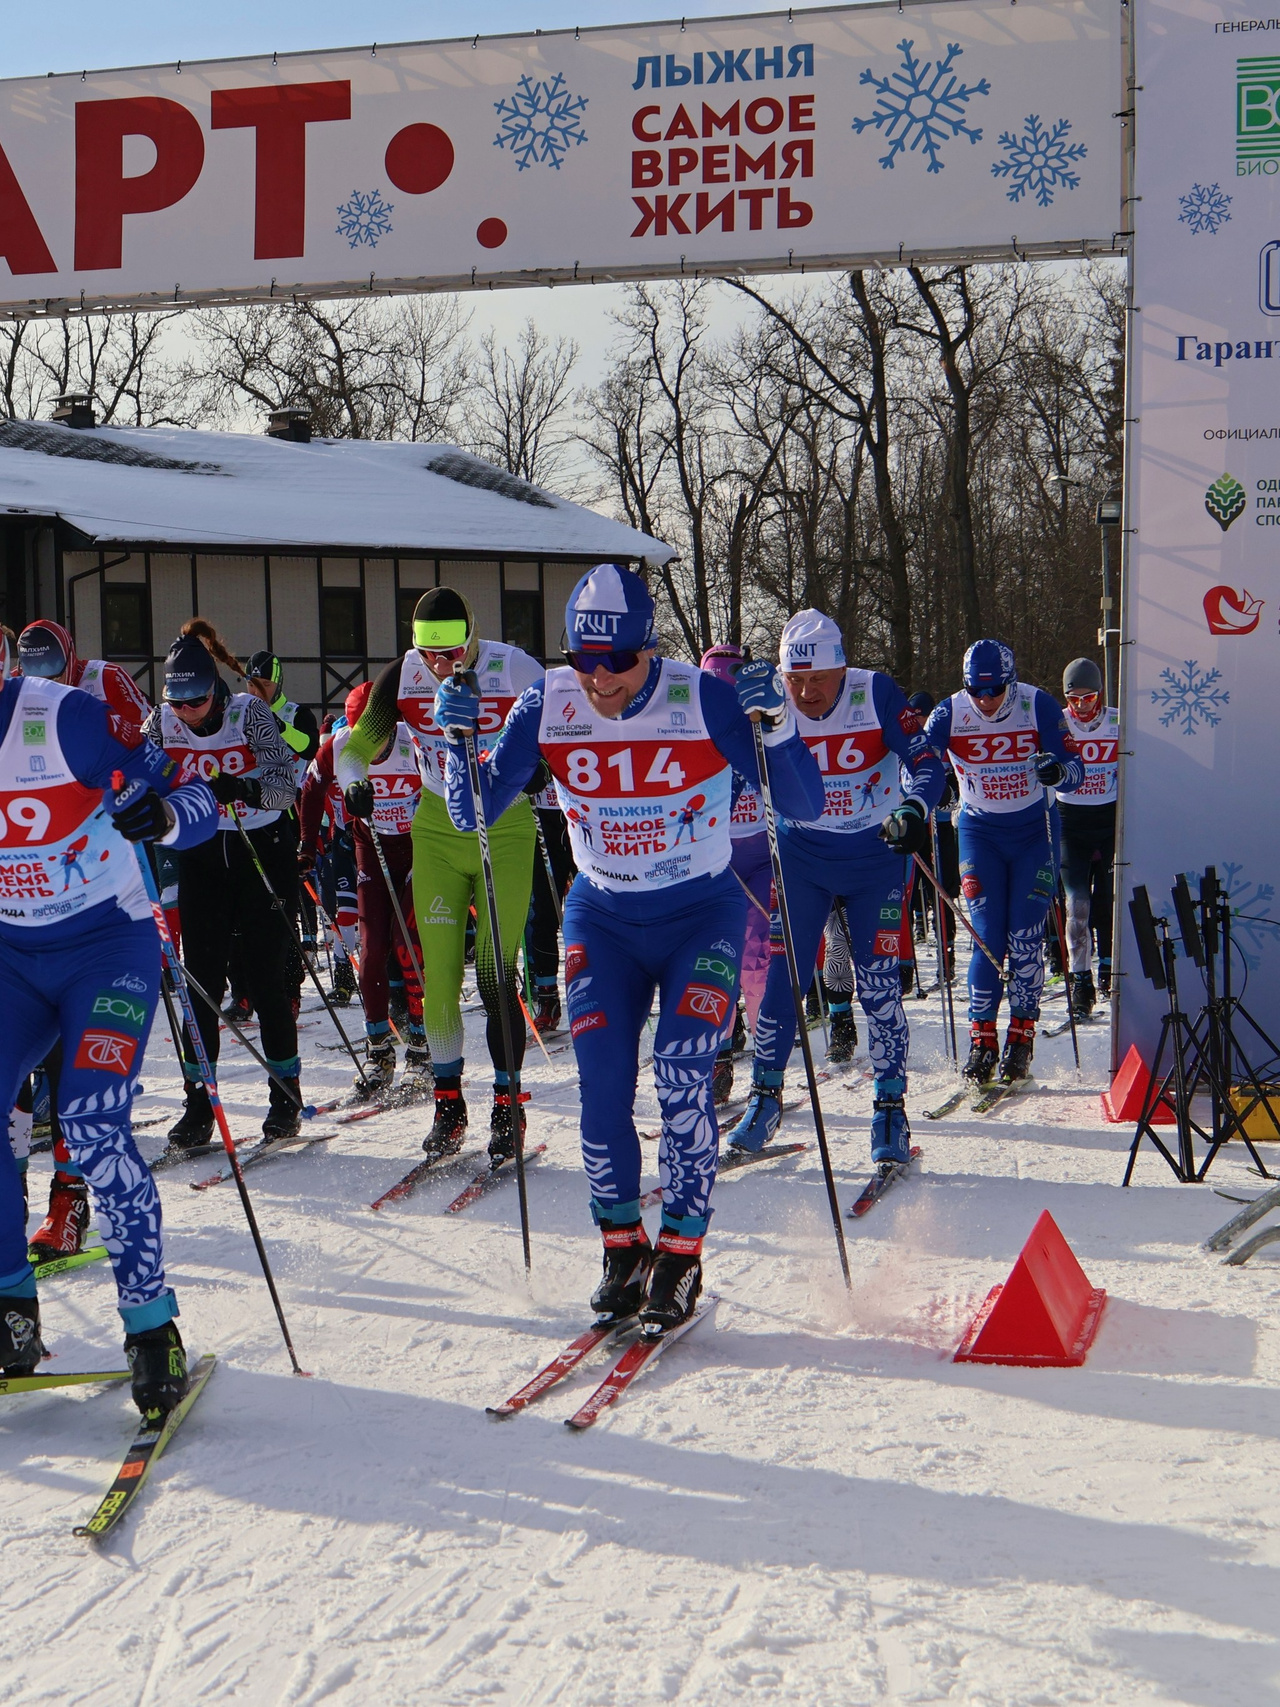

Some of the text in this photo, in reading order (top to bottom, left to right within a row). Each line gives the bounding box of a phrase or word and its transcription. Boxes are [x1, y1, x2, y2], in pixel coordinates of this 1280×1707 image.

[632, 43, 814, 89] ЛЫЖНЯ
[632, 94, 814, 142] САМОЕ
[632, 138, 814, 189] ВРЕМЯ
[631, 185, 814, 237] ЖИТЬ
[1204, 428, 1280, 441] ОФИЦИАЛ
[575, 614, 621, 635] RWT
[786, 643, 817, 657] RWT
[742, 661, 767, 675] COXA
[419, 702, 502, 736] 35
[657, 727, 702, 735] Гарант-Инвест
[968, 734, 1037, 761] 325
[1076, 743, 1116, 761] 07
[182, 751, 245, 782] 408
[566, 747, 686, 792] 814
[980, 765, 1026, 774] ЛЫЖНЯ
[1038, 758, 1053, 769] COXA
[981, 772, 1027, 783] САМОЕ
[982, 780, 1029, 791] ВРЕМЯ
[115, 779, 142, 806] COXA
[984, 790, 1030, 801] ЖИТЬ
[598, 805, 664, 817] ЛЫЖНЯ
[823, 799, 853, 808] ЕМЯ
[600, 818, 666, 832] САМОЕ
[603, 840, 667, 857] ЖИТЬ
[591, 865, 639, 882] КОМАНДА
[694, 957, 735, 986] BCM
[92, 997, 146, 1026] BCM
[660, 1236, 698, 1246] MADSHUS
[38, 1259, 68, 1277] FISCHER
